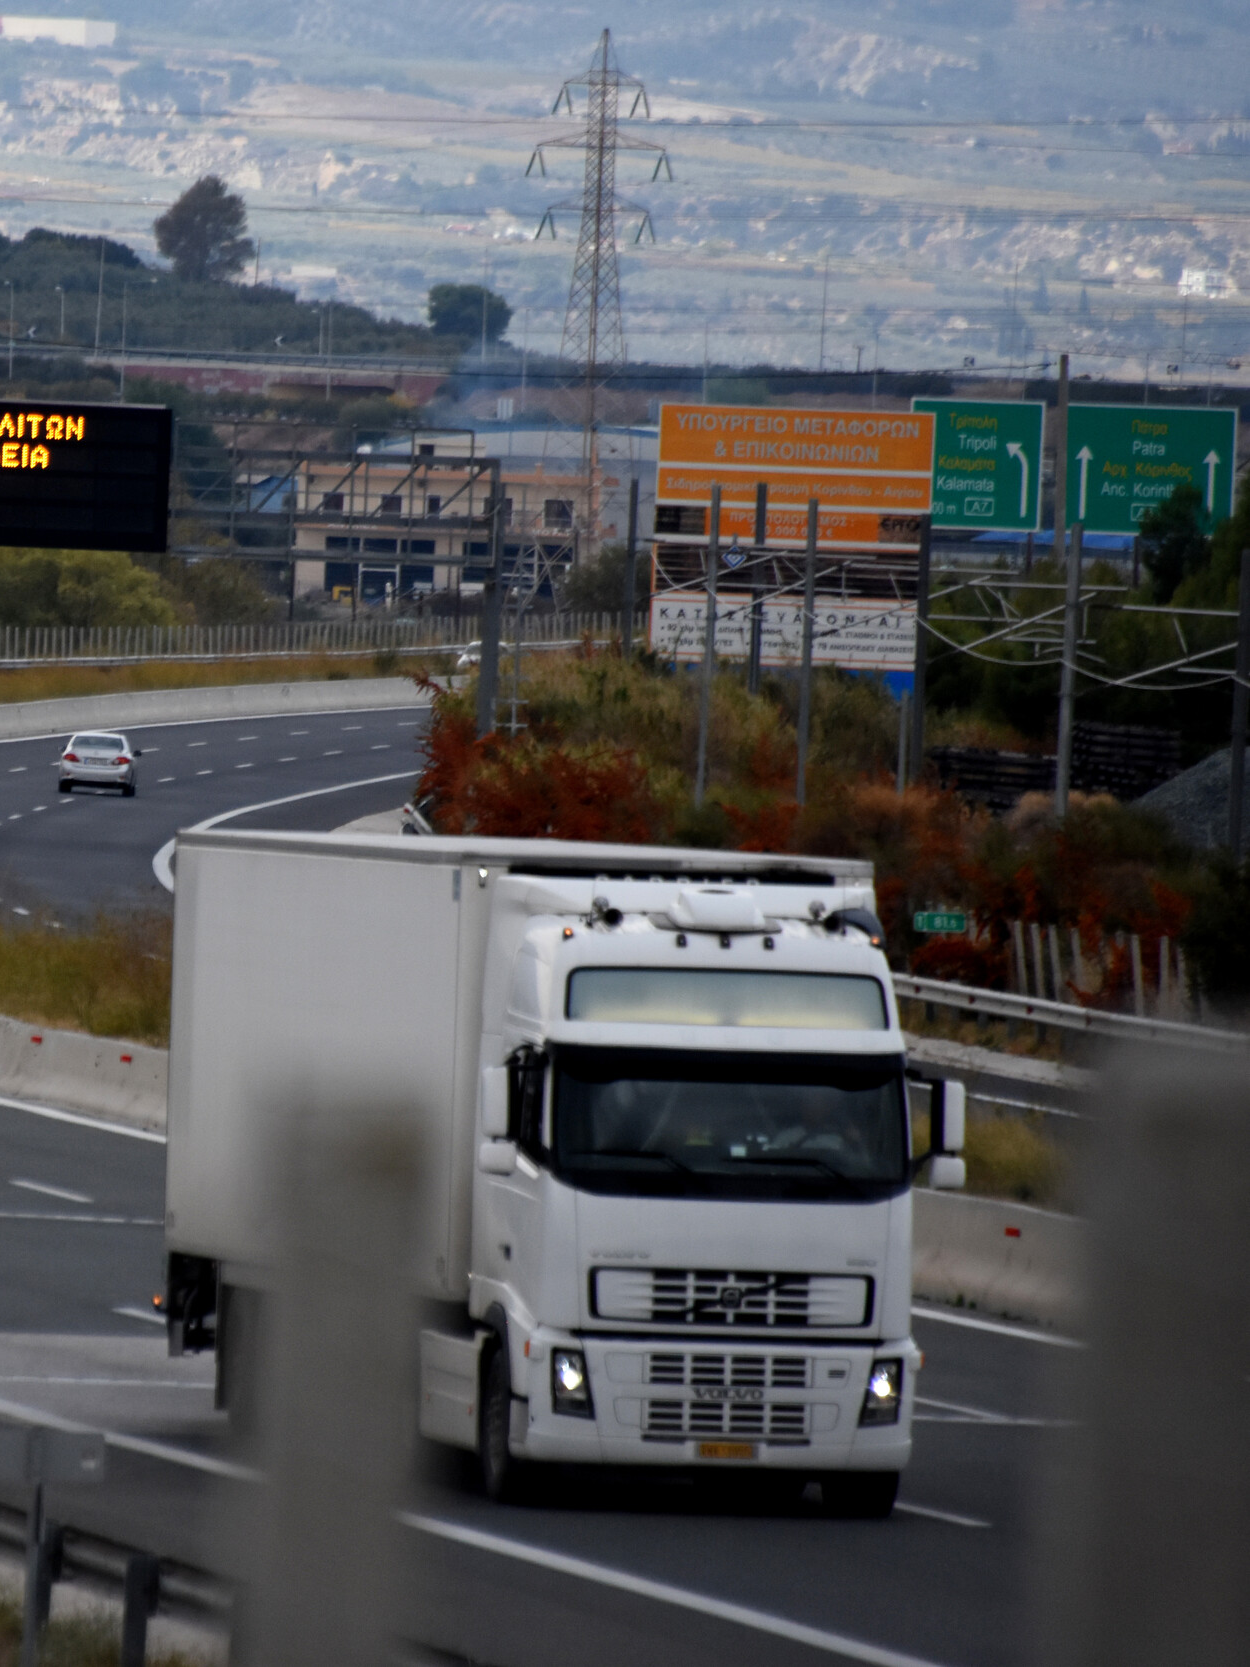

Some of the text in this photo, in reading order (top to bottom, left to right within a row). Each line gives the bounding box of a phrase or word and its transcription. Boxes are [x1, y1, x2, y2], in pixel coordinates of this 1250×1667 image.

[677, 413, 920, 438] ΥΠΟΥΡΓΕΙΟ ΜΕΤΑΦΟΡΩΝ
[715, 440, 880, 463] & ΕΠΙΚΟΙΝΩΝΙΩΝ
[958, 434, 997, 453] Tripoli
[1132, 440, 1166, 456] Patra
[768, 483, 809, 496] ραμμή
[936, 475, 995, 493] Kalamata
[1100, 481, 1129, 497] Anc.
[970, 501, 989, 514] A7
[693, 1387, 764, 1400] VOLVO
